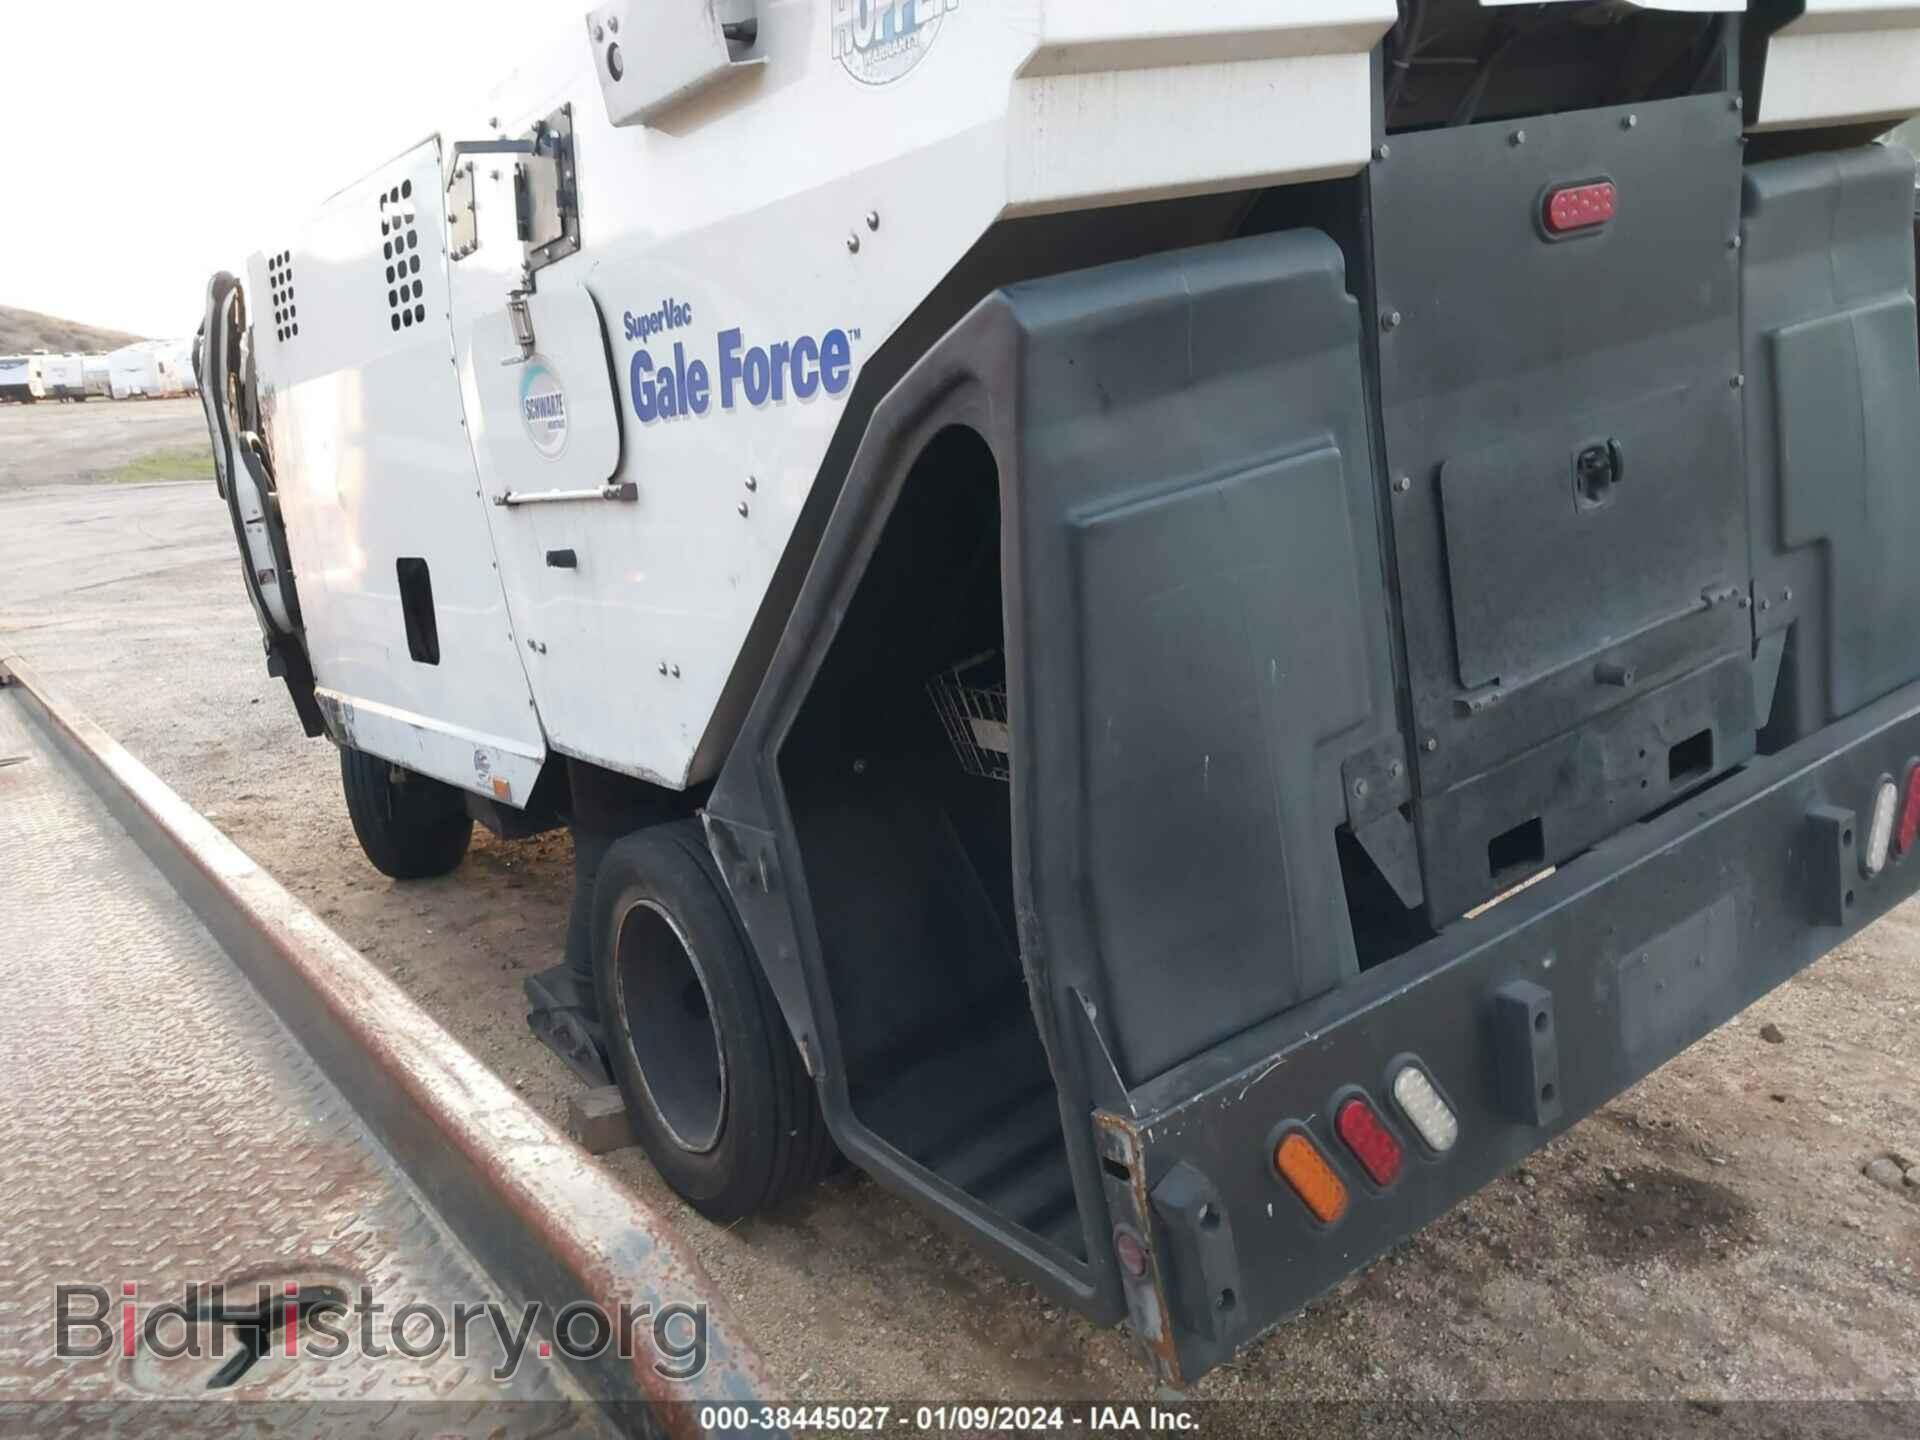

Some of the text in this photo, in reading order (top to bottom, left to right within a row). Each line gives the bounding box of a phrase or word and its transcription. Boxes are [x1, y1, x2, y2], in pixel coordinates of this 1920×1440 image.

[624, 298, 692, 342] SuperVac
[630, 341, 710, 423] Gale
[717, 327, 851, 409] Force
[525, 393, 564, 420] SCHWARZE
